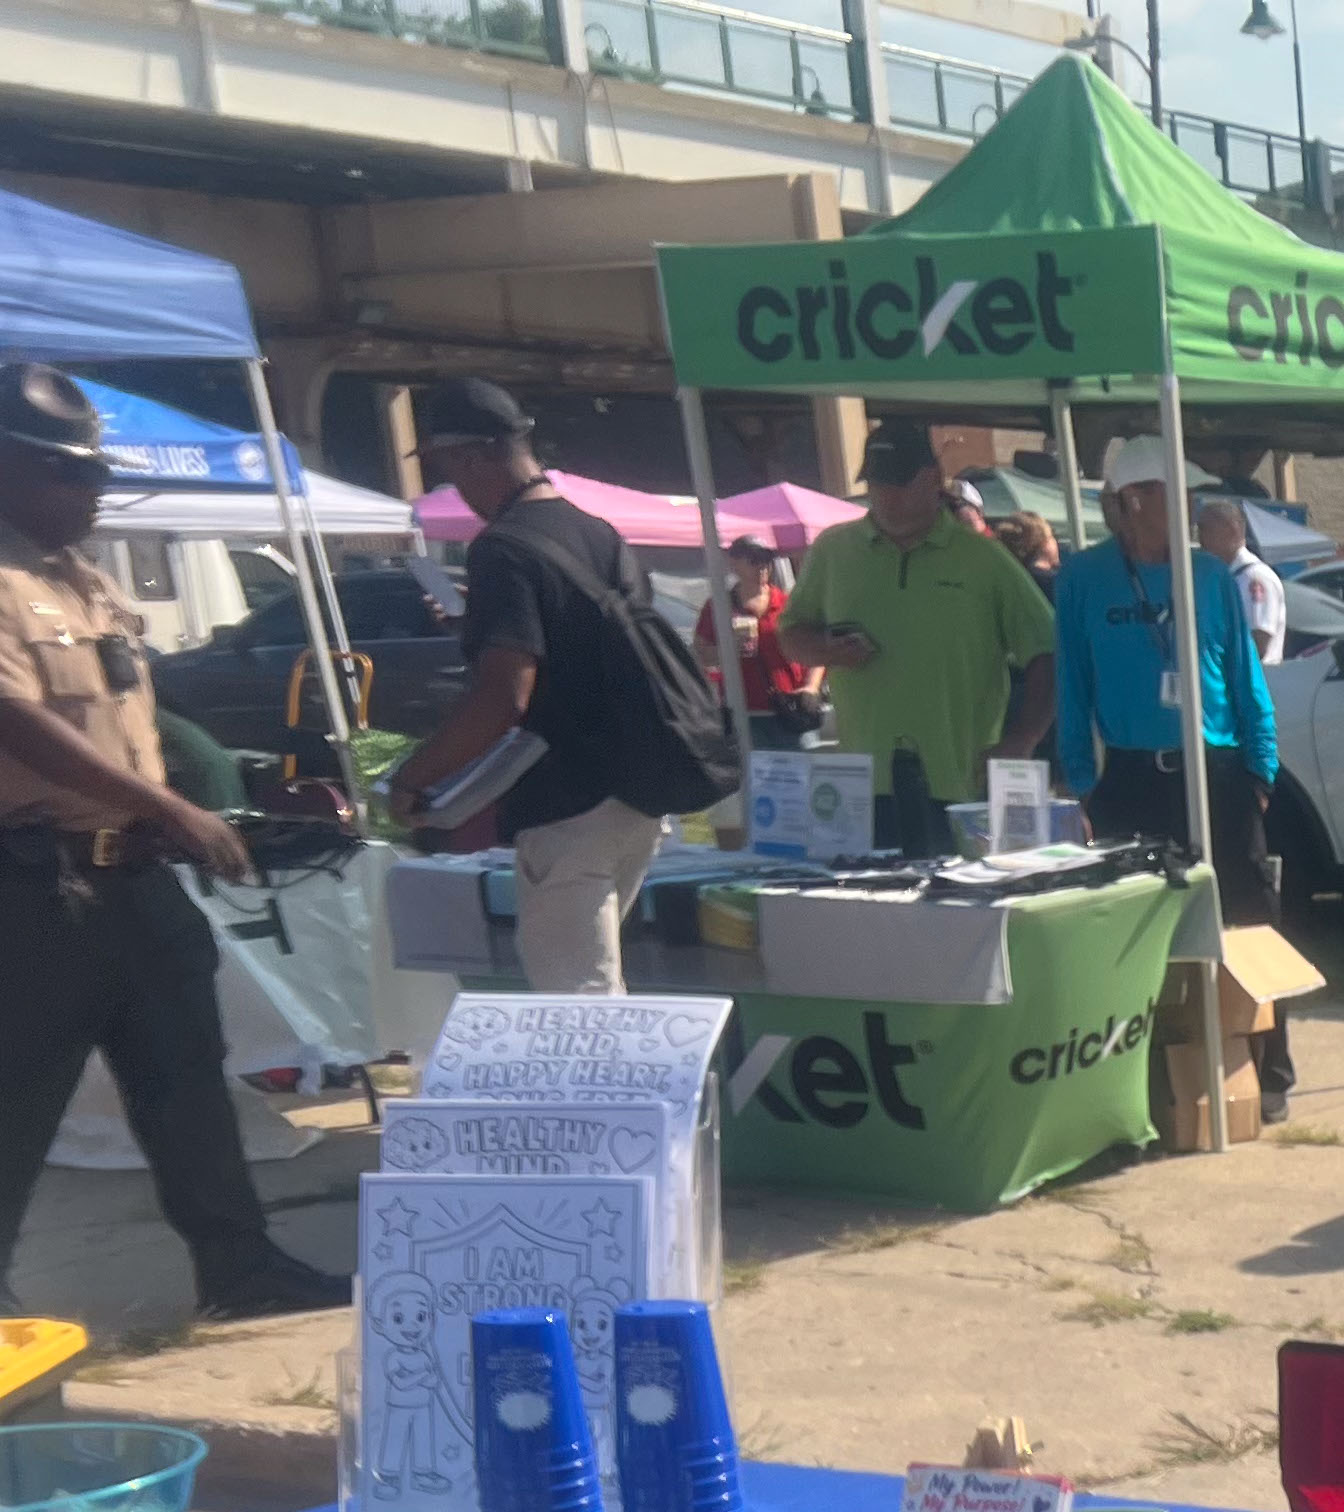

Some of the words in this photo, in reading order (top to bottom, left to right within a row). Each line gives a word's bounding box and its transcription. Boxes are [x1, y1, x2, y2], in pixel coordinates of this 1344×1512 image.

[736, 250, 1073, 362] cricket
[514, 1005, 668, 1034] HEALTHY
[463, 1059, 570, 1091] HAPPY
[453, 1115, 607, 1155] HEALTHY
[464, 1246, 480, 1281] I
[485, 1246, 544, 1282] AM
[928, 1472, 956, 1496] My
[962, 1476, 1020, 1496] Power!
